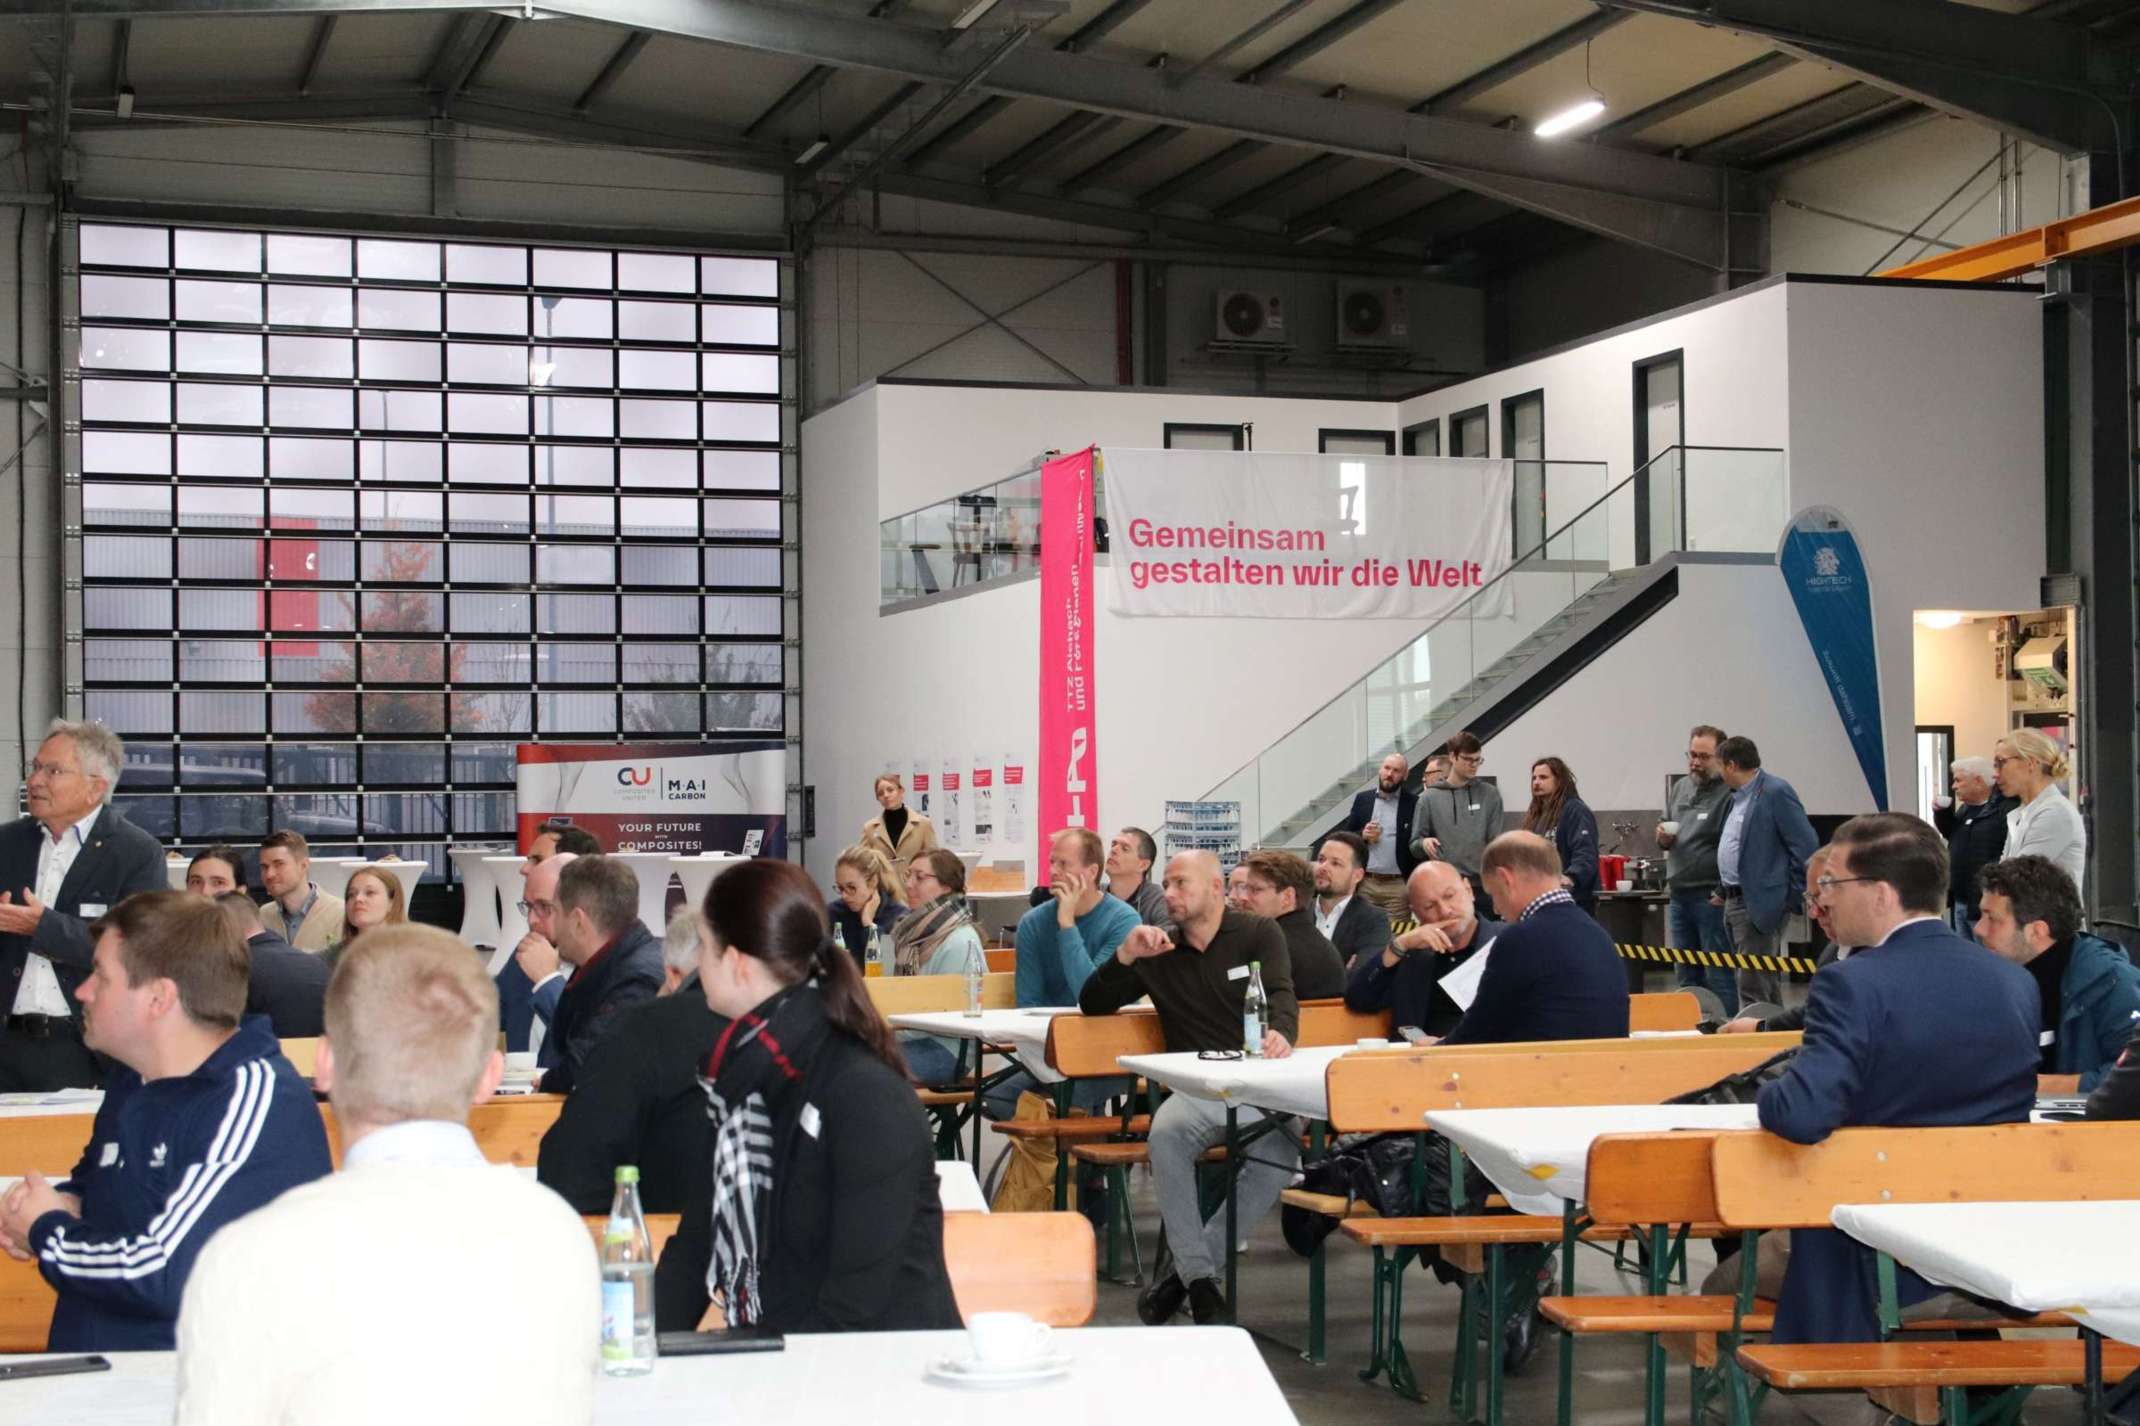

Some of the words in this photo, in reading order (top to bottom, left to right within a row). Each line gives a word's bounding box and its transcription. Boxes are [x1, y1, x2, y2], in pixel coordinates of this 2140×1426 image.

[1129, 518, 1325, 551] Gemeinsam
[1131, 556, 1284, 589] gestalten
[1293, 558, 1344, 586] wir
[1351, 558, 1399, 586] die
[1408, 559, 1482, 588] Welt
[1074, 676, 1086, 711] und
[617, 766, 651, 786] CU
[668, 792, 706, 800] CARBON
[618, 823, 653, 832] YOUR
[656, 823, 702, 832] FUTURE
[617, 841, 702, 850] COMPOSITES!
